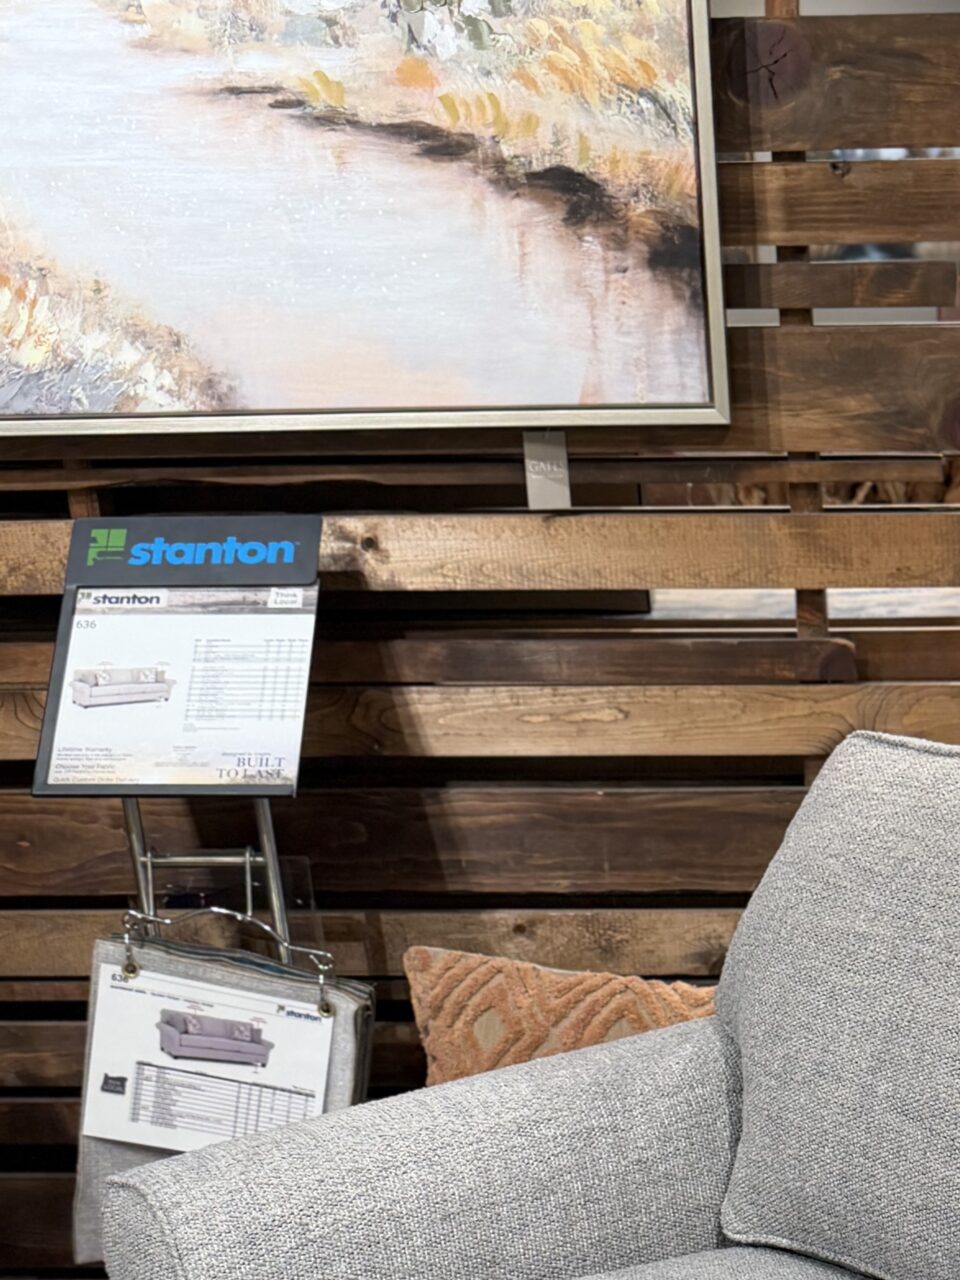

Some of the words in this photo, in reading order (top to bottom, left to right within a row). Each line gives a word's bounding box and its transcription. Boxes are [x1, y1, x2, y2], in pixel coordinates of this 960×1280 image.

[127, 536, 296, 566] stanton
[92, 593, 161, 605] stanton
[75, 620, 97, 630] 636
[236, 757, 286, 768] BUILT
[216, 768, 239, 779] TO
[241, 769, 285, 779] LAST
[285, 1009, 322, 1023] stanton
